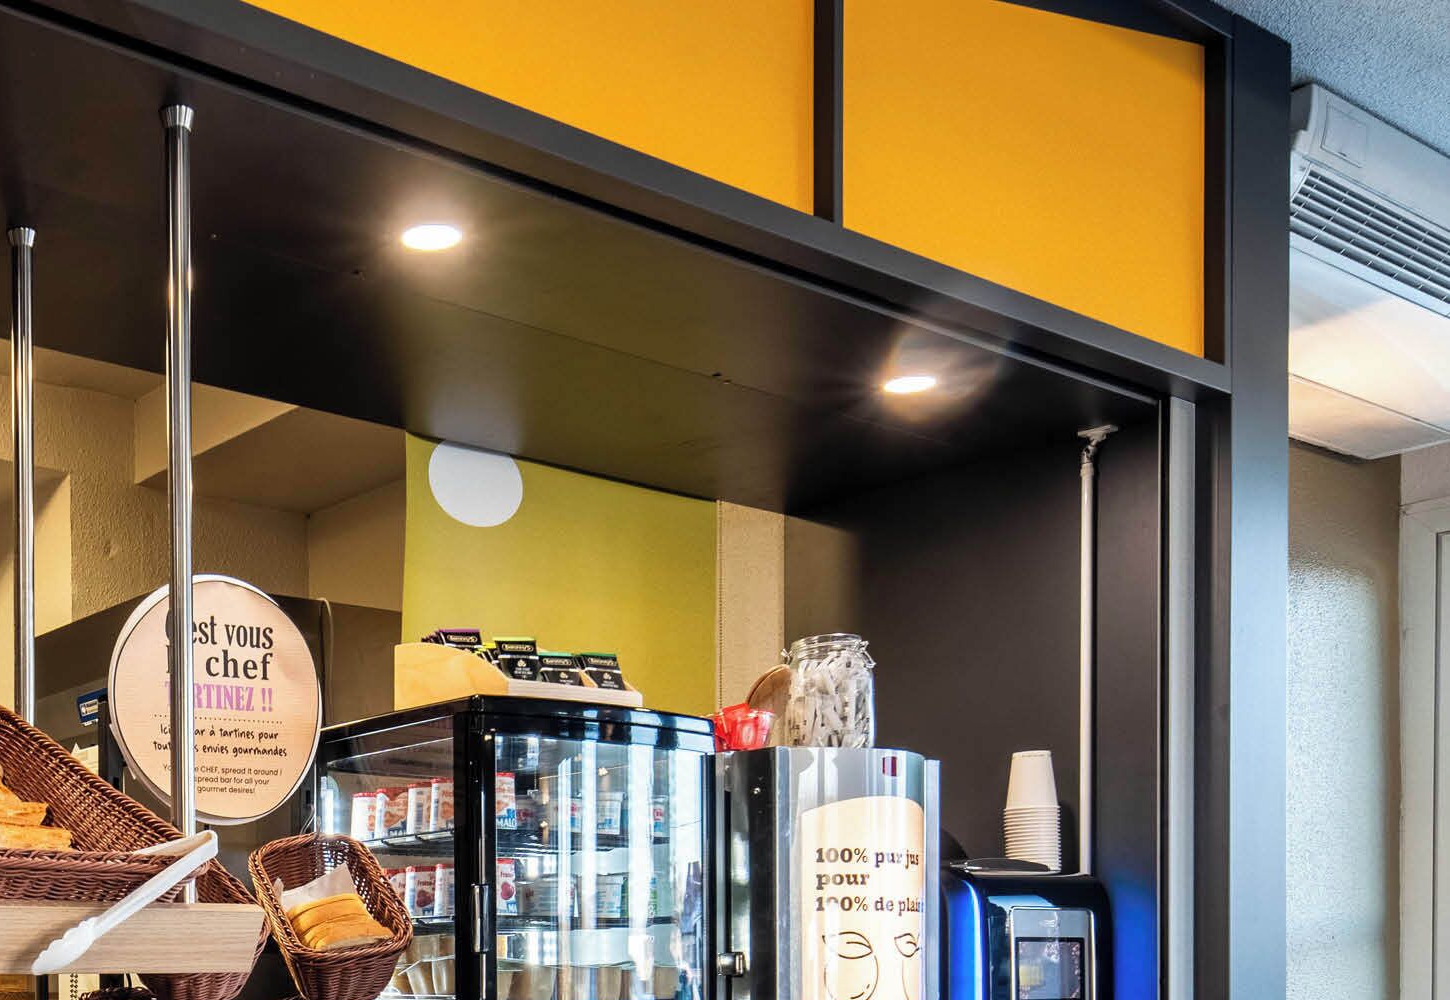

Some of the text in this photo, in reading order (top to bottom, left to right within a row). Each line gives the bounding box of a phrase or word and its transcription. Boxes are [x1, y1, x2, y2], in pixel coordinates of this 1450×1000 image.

[225, 624, 274, 650] vous
[205, 649, 273, 681] chef
[165, 681, 255, 712] RTINEZ
[209, 724, 216, 737] à
[219, 727, 255, 740] tartines
[258, 732, 279, 743] pour
[152, 740, 171, 751] tout
[202, 743, 229, 754] envies
[232, 746, 287, 758] gourmandes
[221, 766, 246, 777] spread
[254, 767, 279, 776] around
[197, 784, 228, 795] gourmet
[220, 775, 233, 784] bar
[233, 775, 244, 784] for
[254, 778, 270, 788] your
[815, 847, 920, 870] 100% pur jus
[815, 872, 871, 891] pour
[874, 896, 895, 912] de
